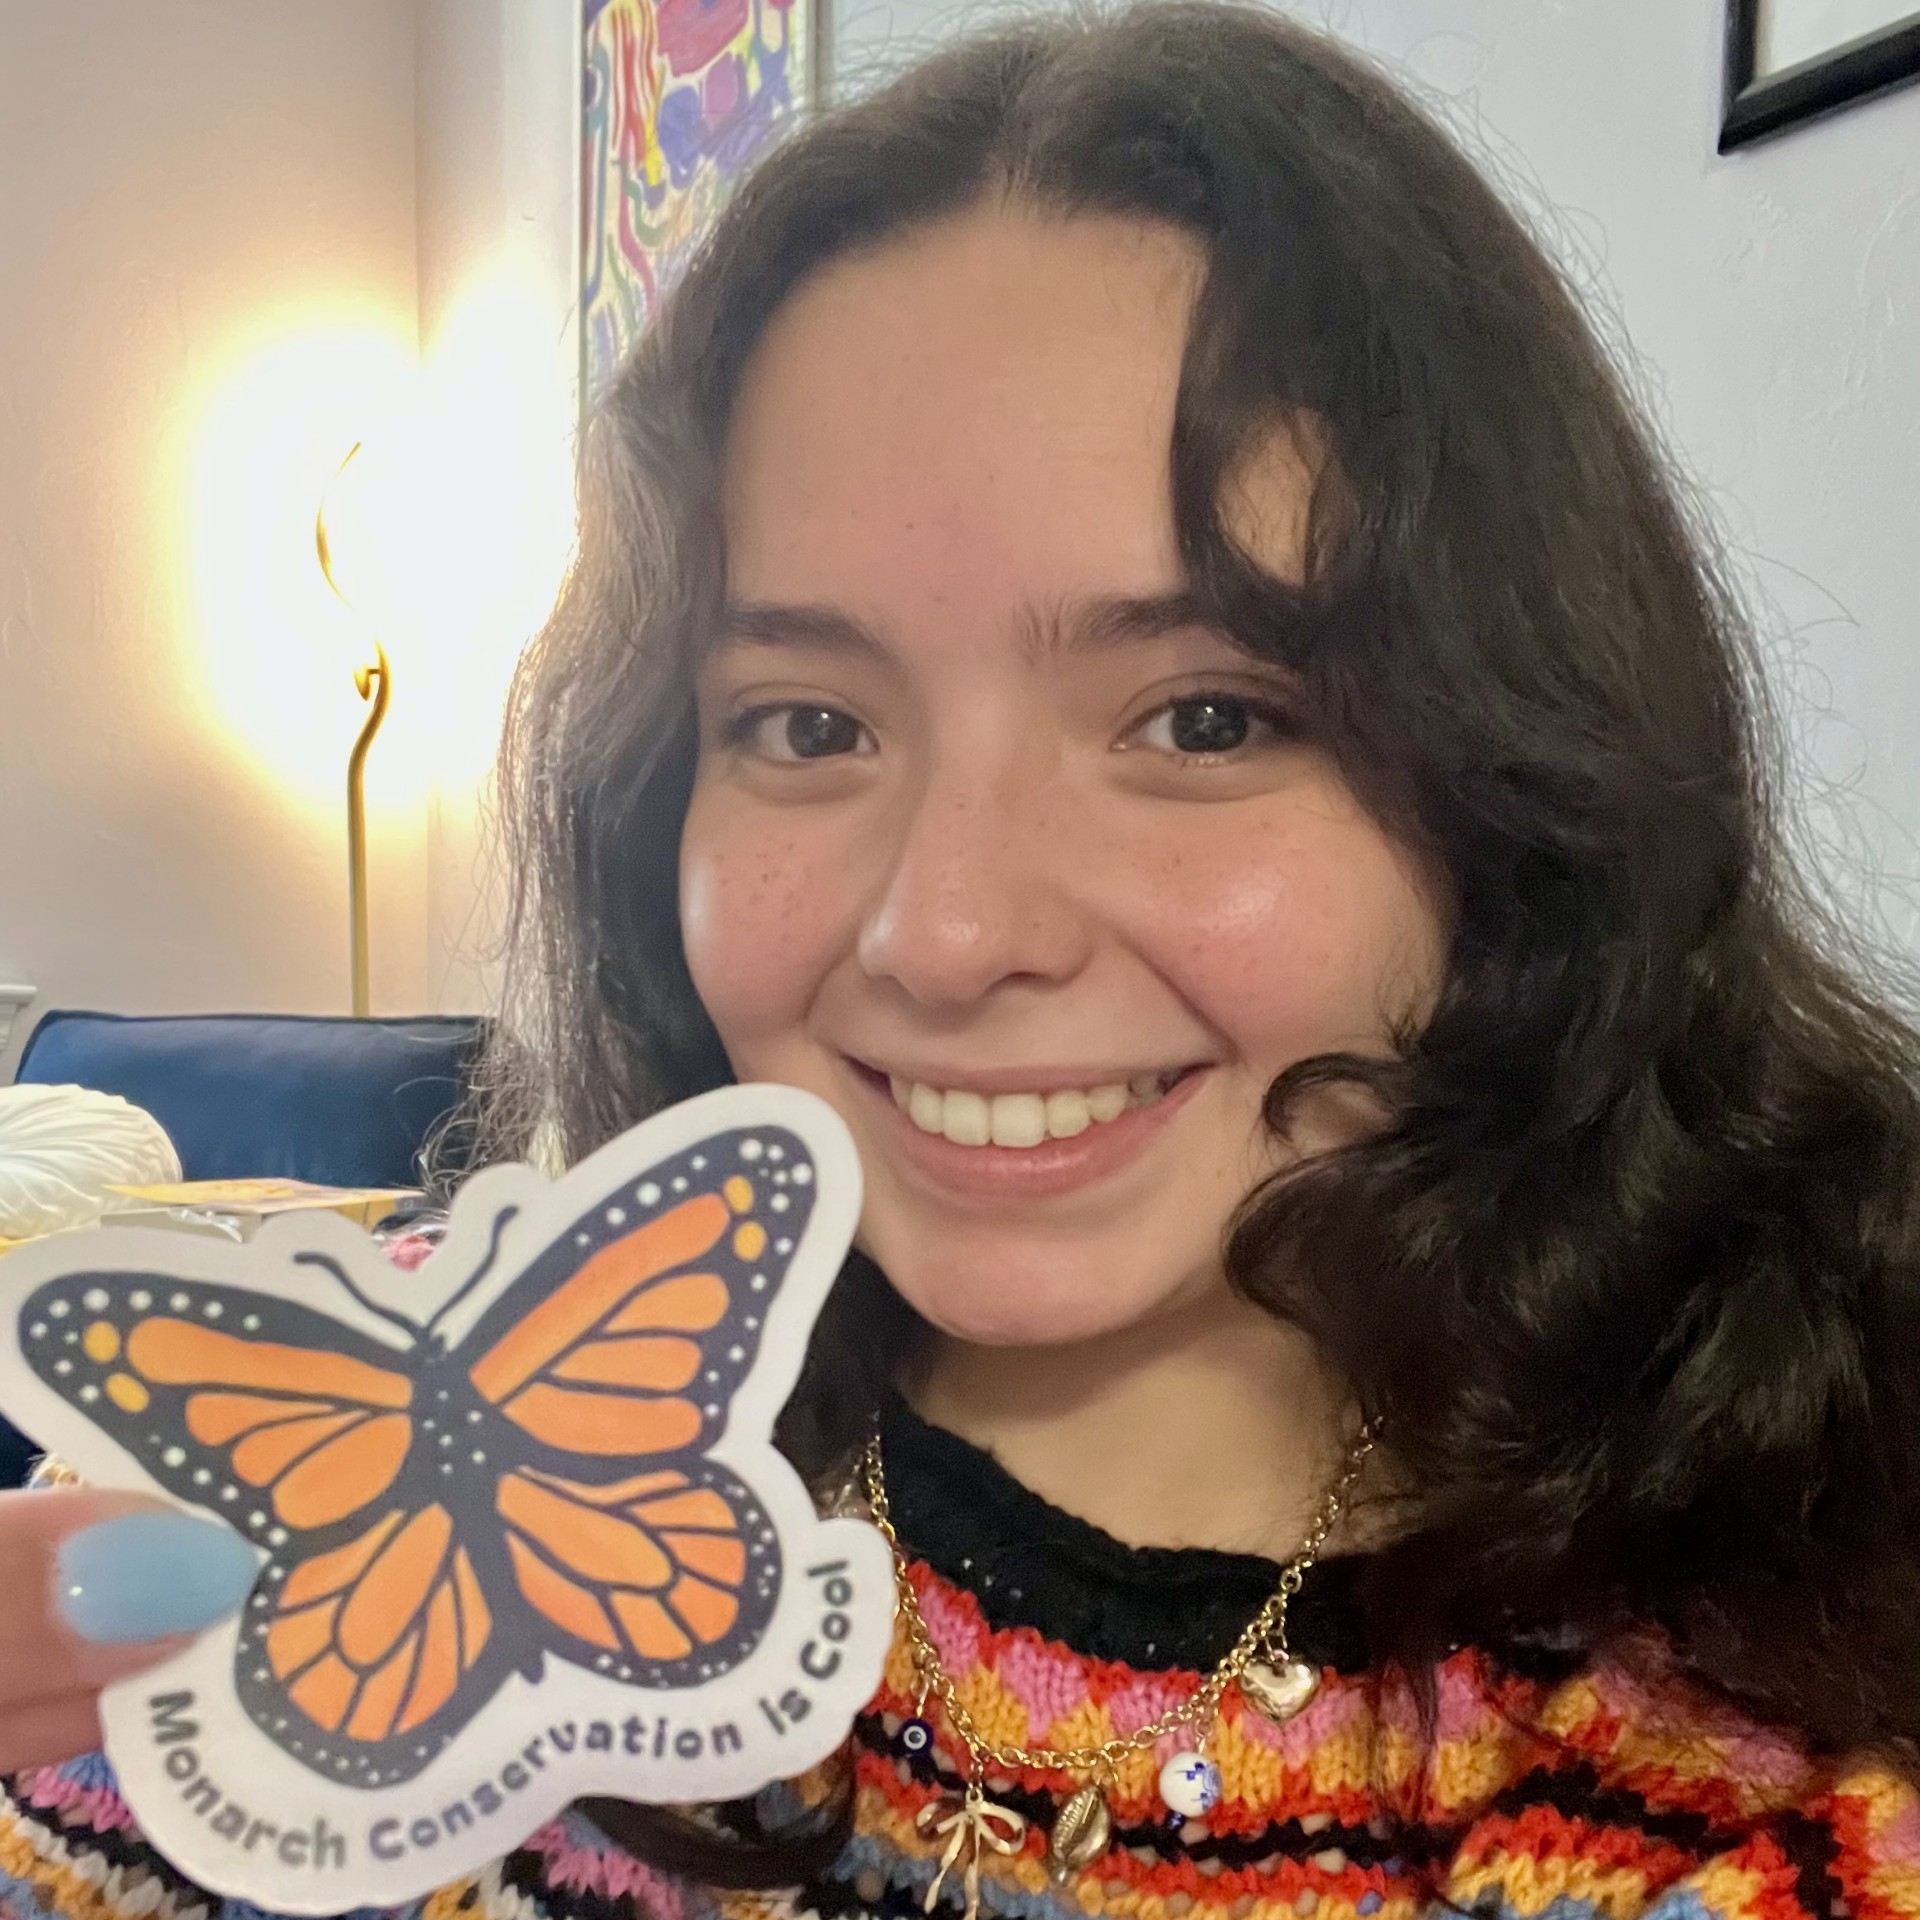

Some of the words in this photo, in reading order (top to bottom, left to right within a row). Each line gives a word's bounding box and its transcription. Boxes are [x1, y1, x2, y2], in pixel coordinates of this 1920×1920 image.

[150, 1690, 346, 1870] Monarch
[369, 1714, 742, 1860] Conservation
[760, 1688, 812, 1736] Is
[801, 1559, 853, 1680] Cool
